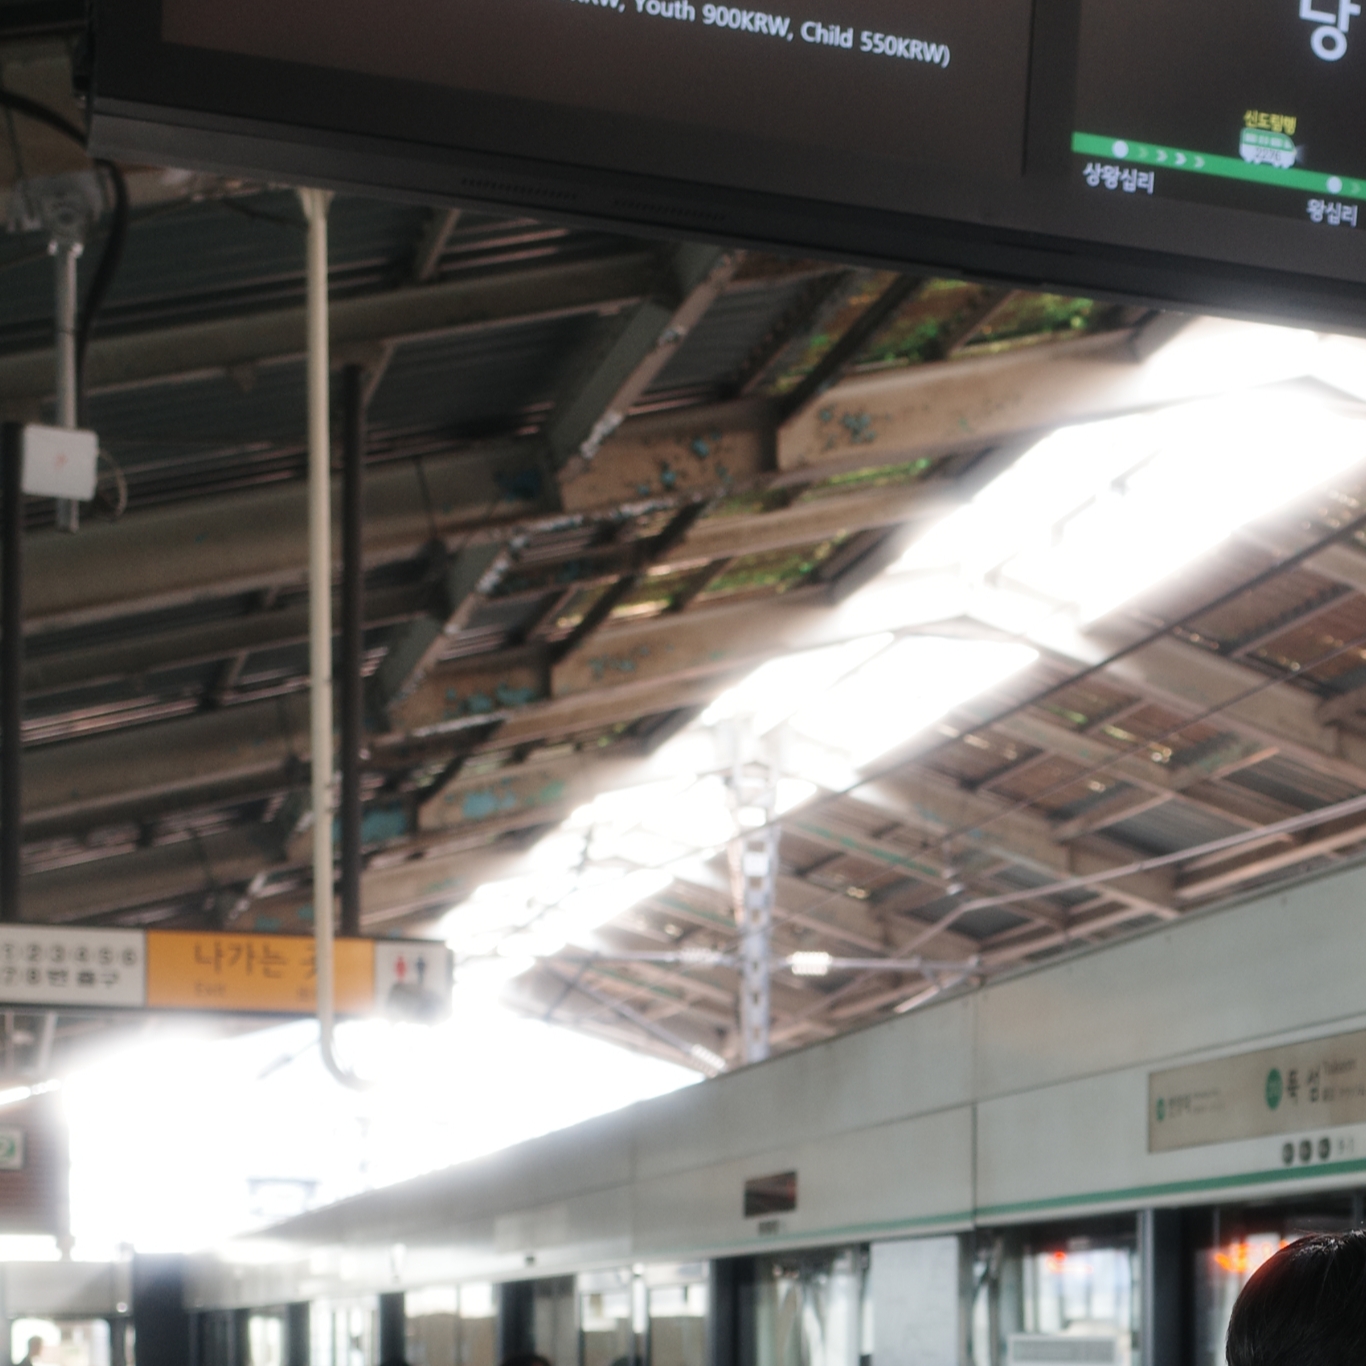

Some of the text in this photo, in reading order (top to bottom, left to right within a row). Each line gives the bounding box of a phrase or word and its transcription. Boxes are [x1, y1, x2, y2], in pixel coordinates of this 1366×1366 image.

[635, 0, 951, 68] Youth 900KRW, Child 550KRW)
[1083, 162, 1155, 194] 상왕십리
[1306, 198, 1358, 228] 왕십리
[194, 941, 288, 978] 나가는
